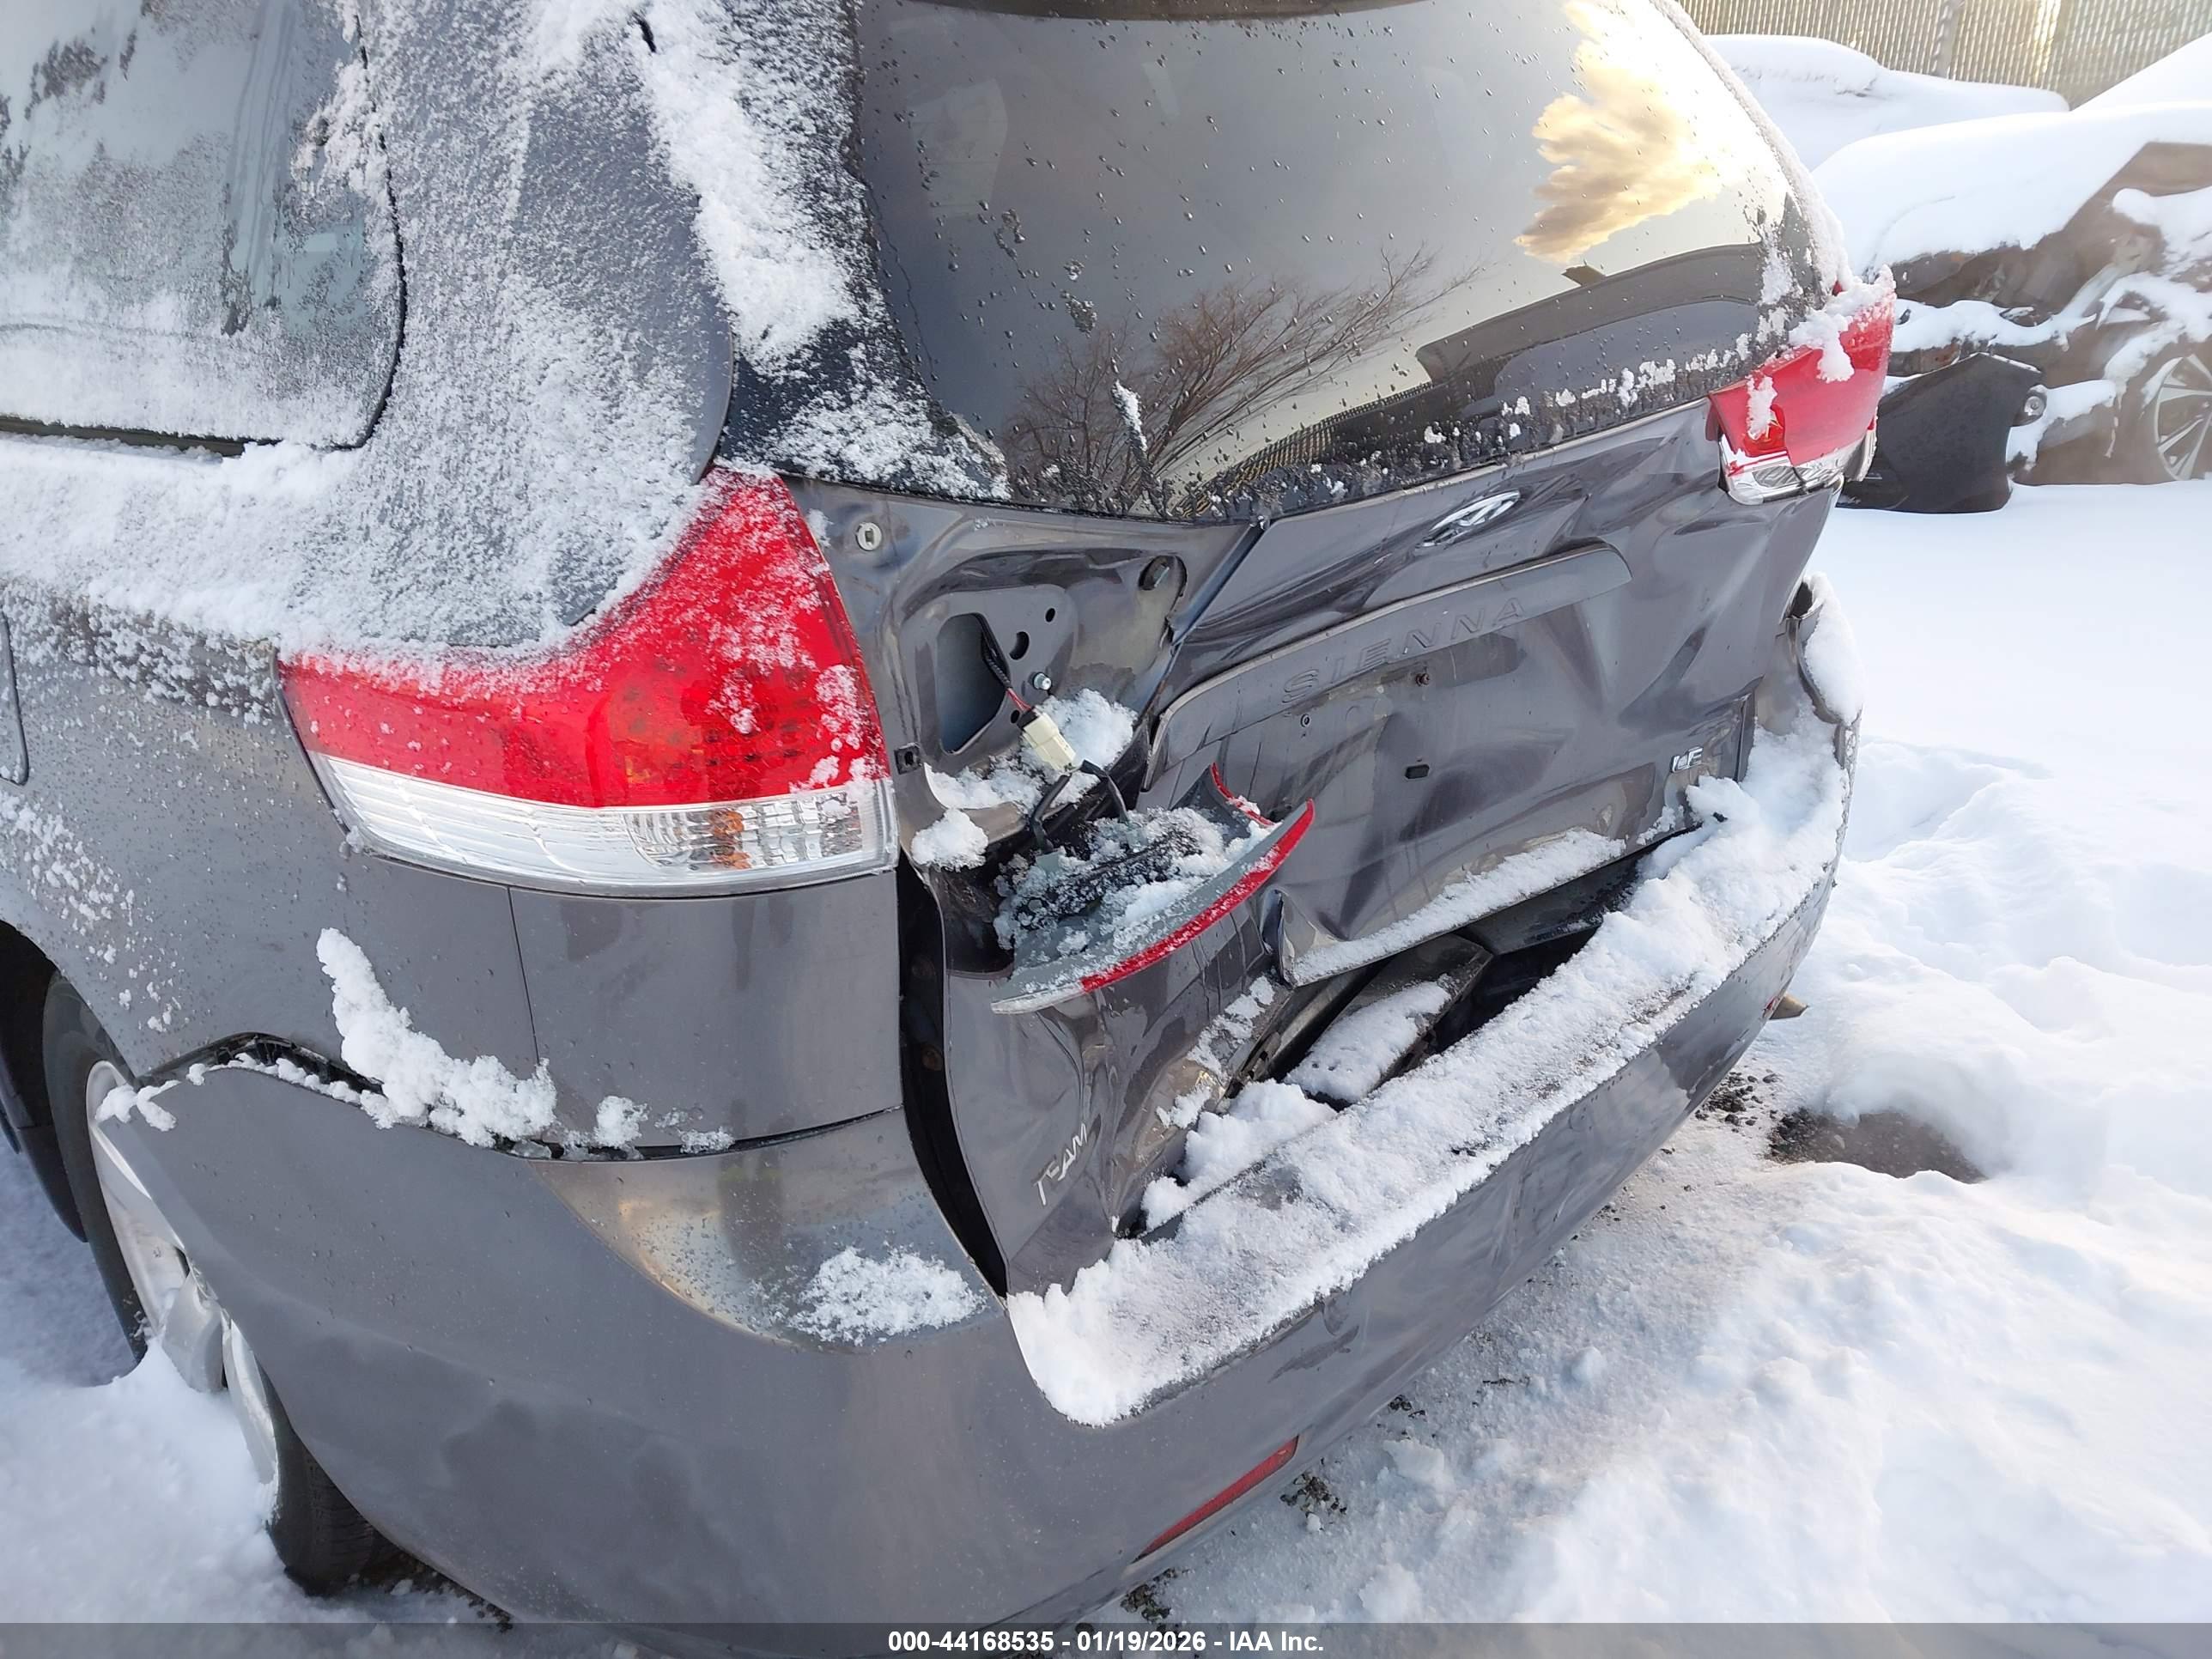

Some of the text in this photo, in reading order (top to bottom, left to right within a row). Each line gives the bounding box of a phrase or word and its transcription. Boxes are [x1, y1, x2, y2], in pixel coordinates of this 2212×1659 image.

[1282, 598, 1525, 704] SIENNA
[1670, 747, 1704, 773] LE
[1033, 1122, 1088, 1206] TEAM
